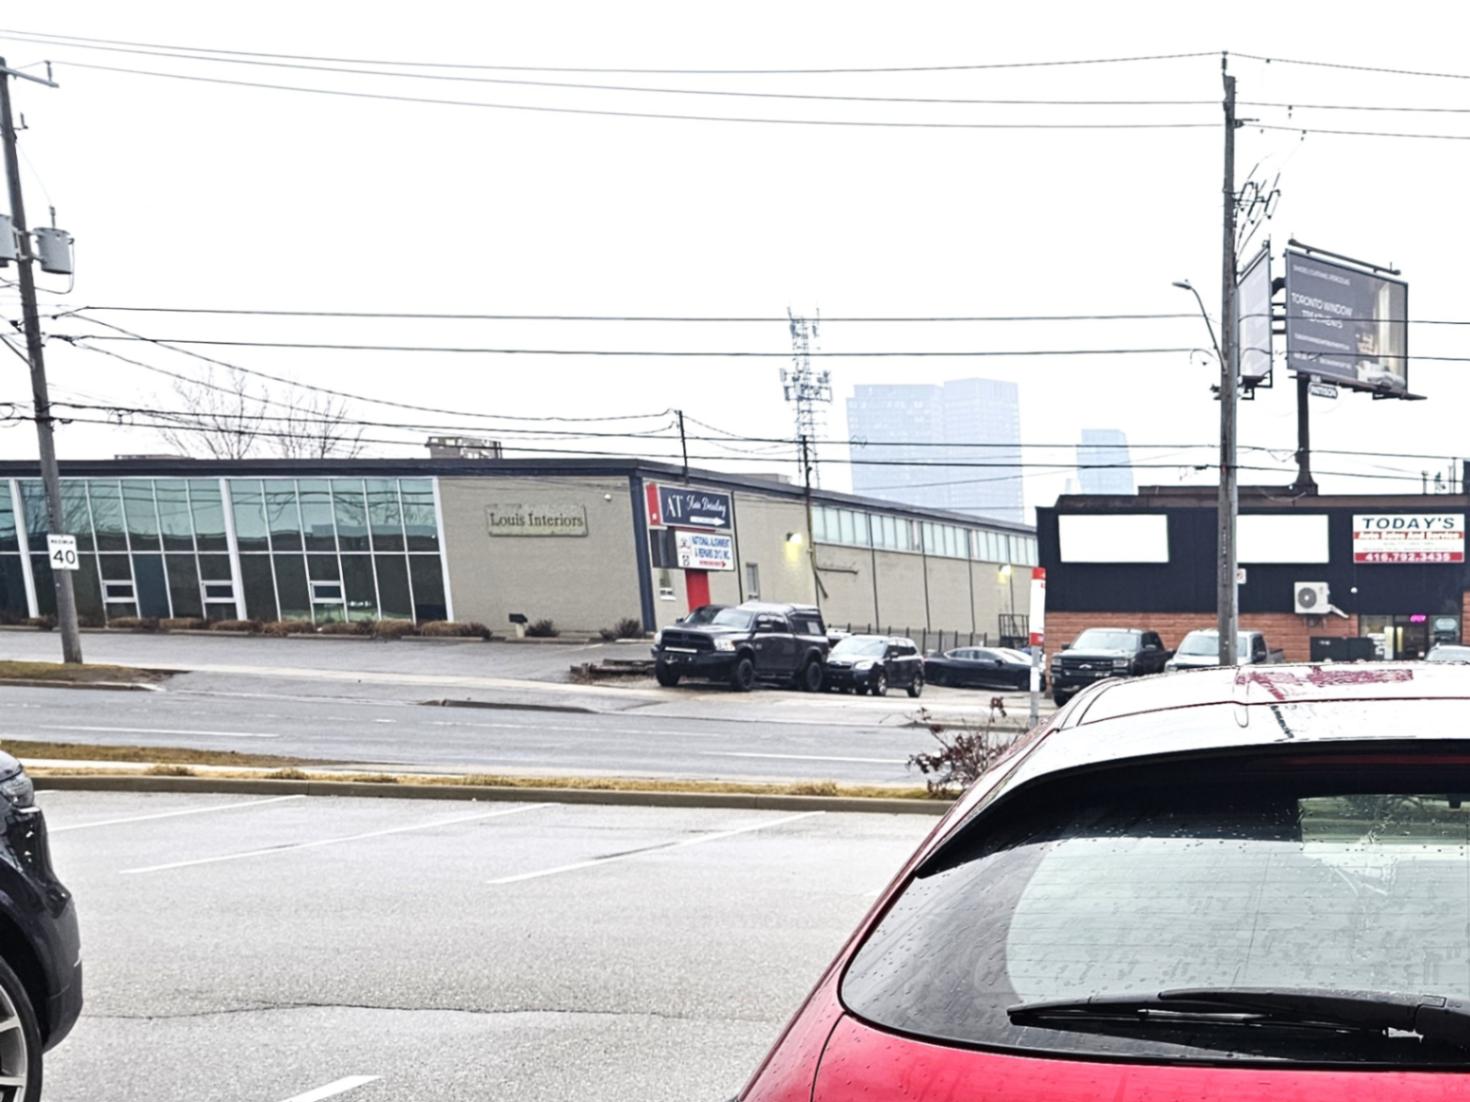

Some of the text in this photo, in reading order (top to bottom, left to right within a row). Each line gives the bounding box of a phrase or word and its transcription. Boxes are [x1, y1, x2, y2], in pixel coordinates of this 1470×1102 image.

[665, 494, 684, 518] AT
[490, 511, 585, 527] Louis Interiors
[1362, 517, 1455, 530] TODAY'S
[53, 549, 76, 565] 40
